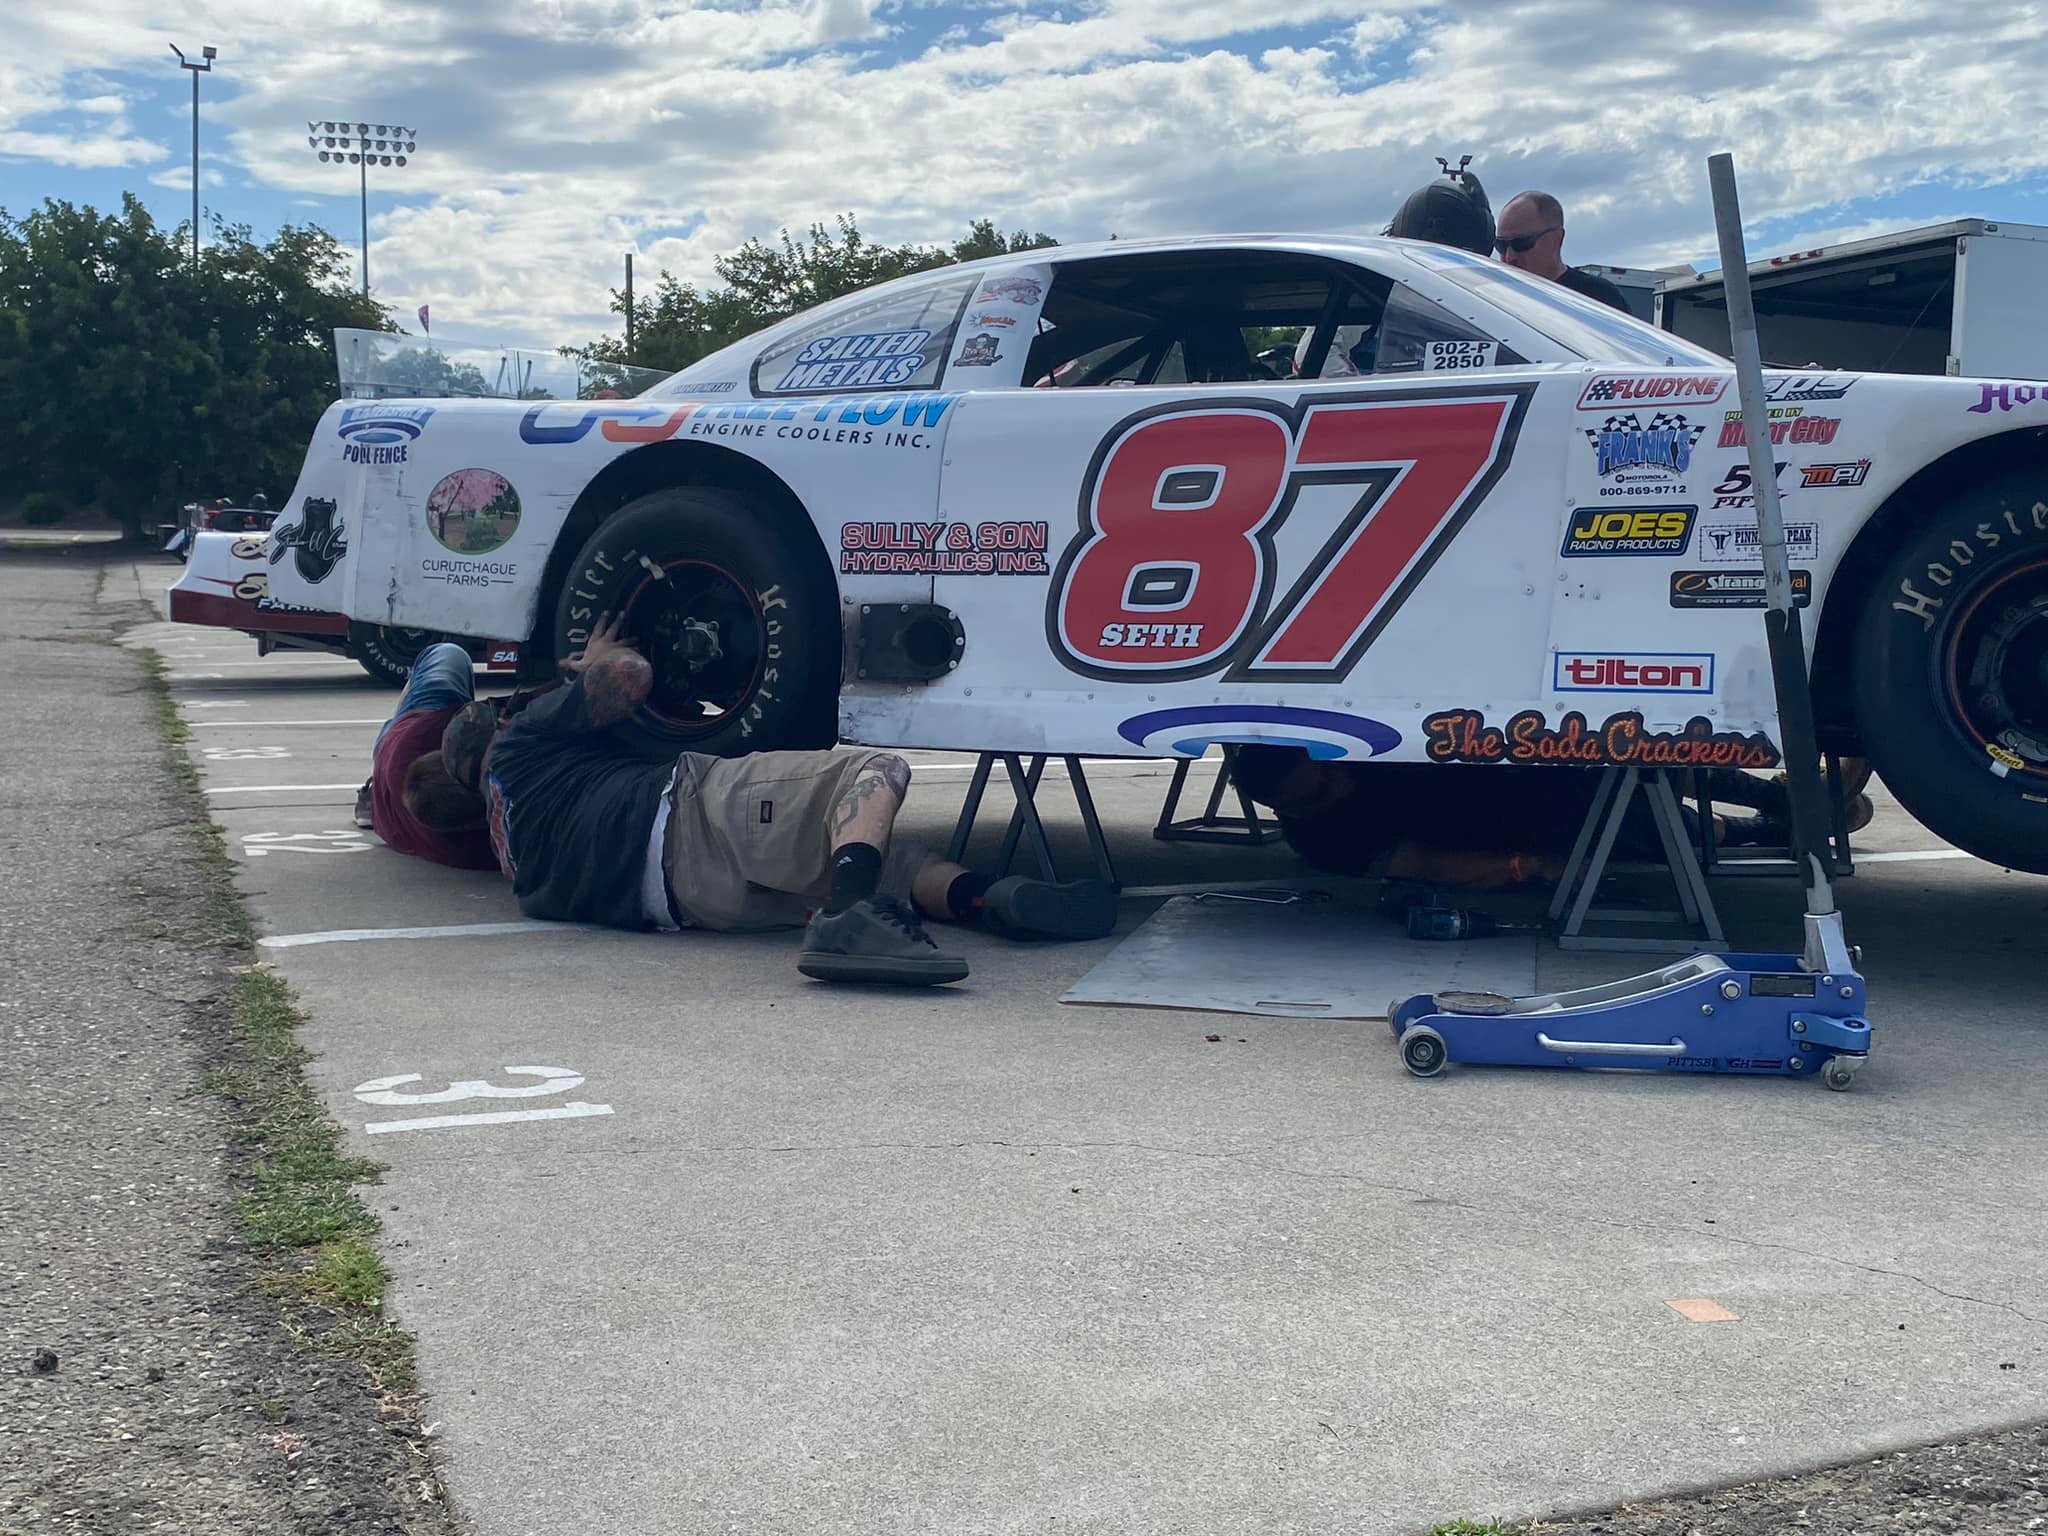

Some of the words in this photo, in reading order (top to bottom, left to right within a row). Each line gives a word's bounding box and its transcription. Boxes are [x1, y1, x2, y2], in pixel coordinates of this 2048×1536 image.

[799, 330, 930, 362] SALTED
[1433, 342, 1491, 356] 602-P
[775, 356, 923, 390] METALS
[1434, 355, 1485, 370] 2850
[1612, 376, 1721, 399] FLUIDYNE
[814, 392, 957, 428] FLOW
[690, 422, 767, 437] ENGINE
[777, 426, 873, 444] COOLERS
[885, 433, 932, 448] INC.
[1789, 416, 1842, 446] City
[343, 444, 371, 464] POOL
[374, 444, 407, 464] FENCE
[1600, 485, 1687, 496] 800-869-9712
[841, 522, 944, 550] SULLY
[947, 522, 973, 549] &
[978, 522, 1047, 550] SON
[1045, 382, 1540, 683] 87
[1574, 512, 1688, 539] JOES
[1787, 529, 1812, 542] PEAK
[1570, 540, 1614, 551] RACING
[1616, 538, 1681, 550] PRODUCTS
[422, 560, 517, 575] CURUTCHAGUE
[841, 552, 994, 572] HYDRAULICS
[998, 552, 1048, 572] INC.
[446, 574, 489, 587] FARMS
[1706, 573, 1766, 591] Strang
[1099, 623, 1203, 647] SETH
[492, 651, 518, 662] SA
[740, 584, 788, 737] Hoosier
[1565, 659, 1702, 687] tilton
[1430, 714, 1500, 757] The
[1512, 717, 1601, 760] Soda
[1607, 719, 1773, 765] Crackers
[240, 830, 375, 857] 32
[1666, 1056, 1751, 1069] PITTSBGH
